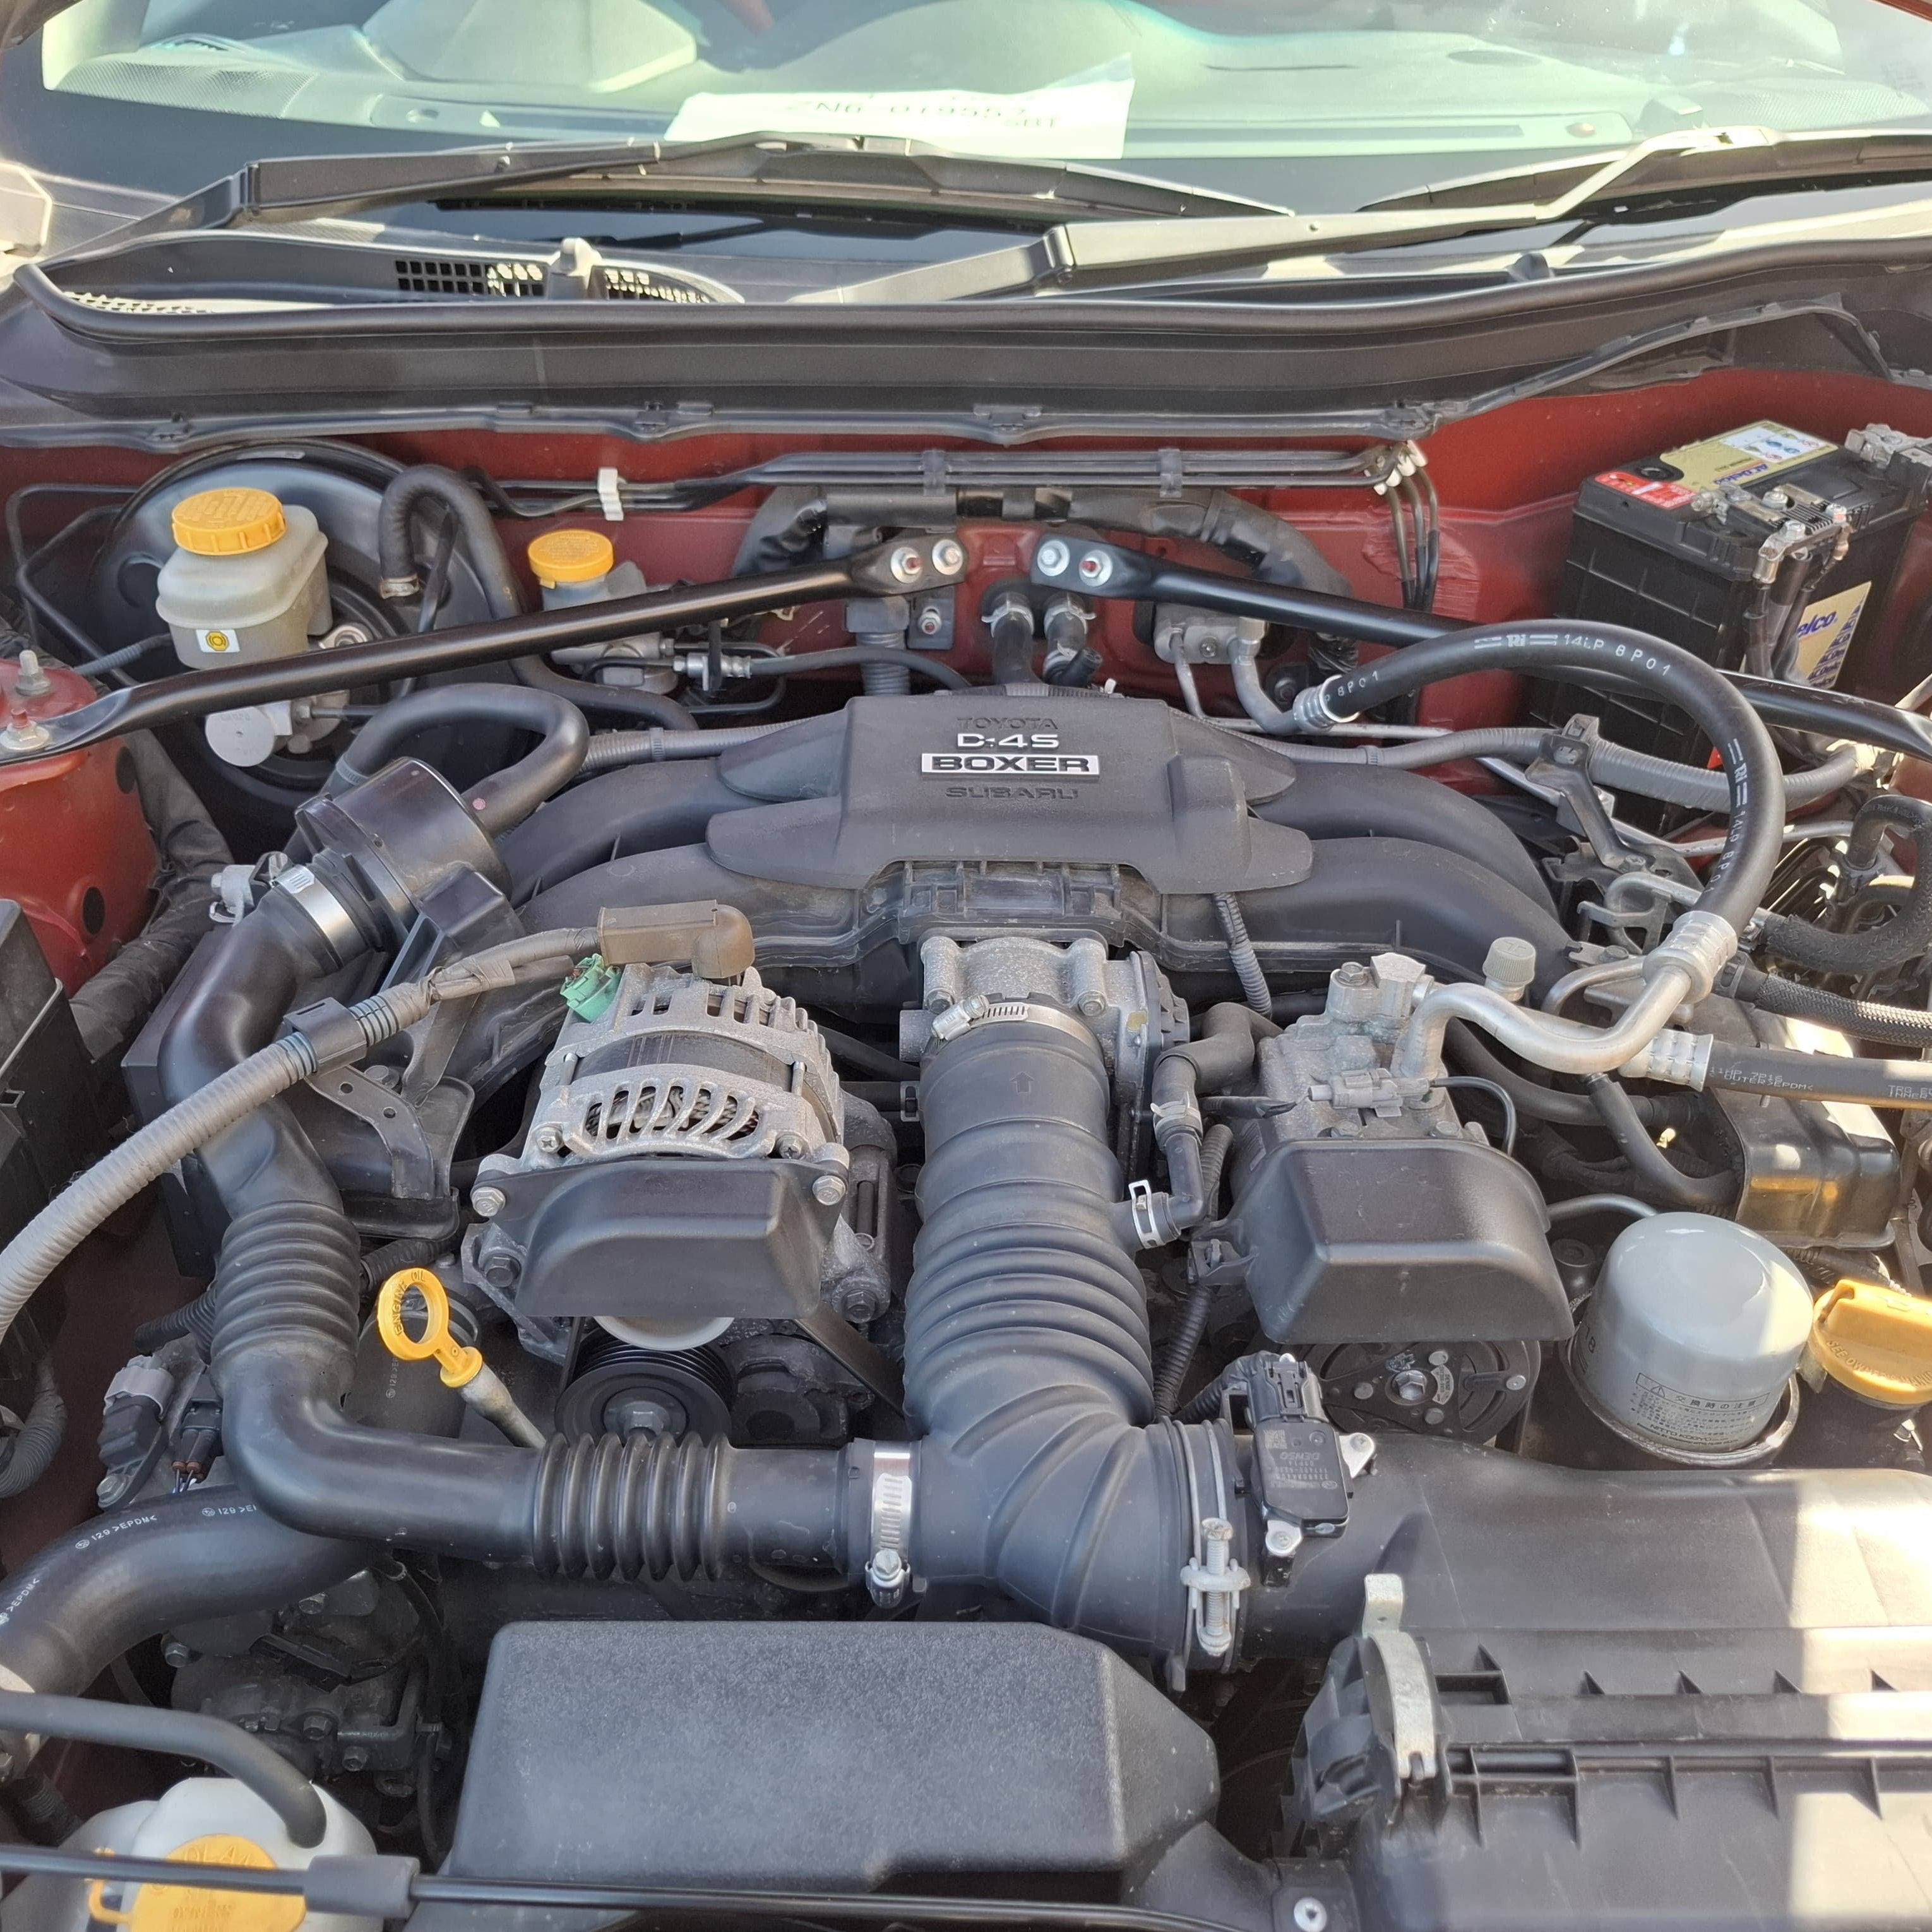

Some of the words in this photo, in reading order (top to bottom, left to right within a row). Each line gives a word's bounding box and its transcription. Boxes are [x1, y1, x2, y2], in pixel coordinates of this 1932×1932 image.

[957, 717, 1059, 730] TOYOTA
[931, 756, 1090, 772] BOXER
[946, 785, 1078, 800] SUBARU
[410, 1270, 426, 1282] OIL
[1279, 1452, 1320, 1460] DENSO
